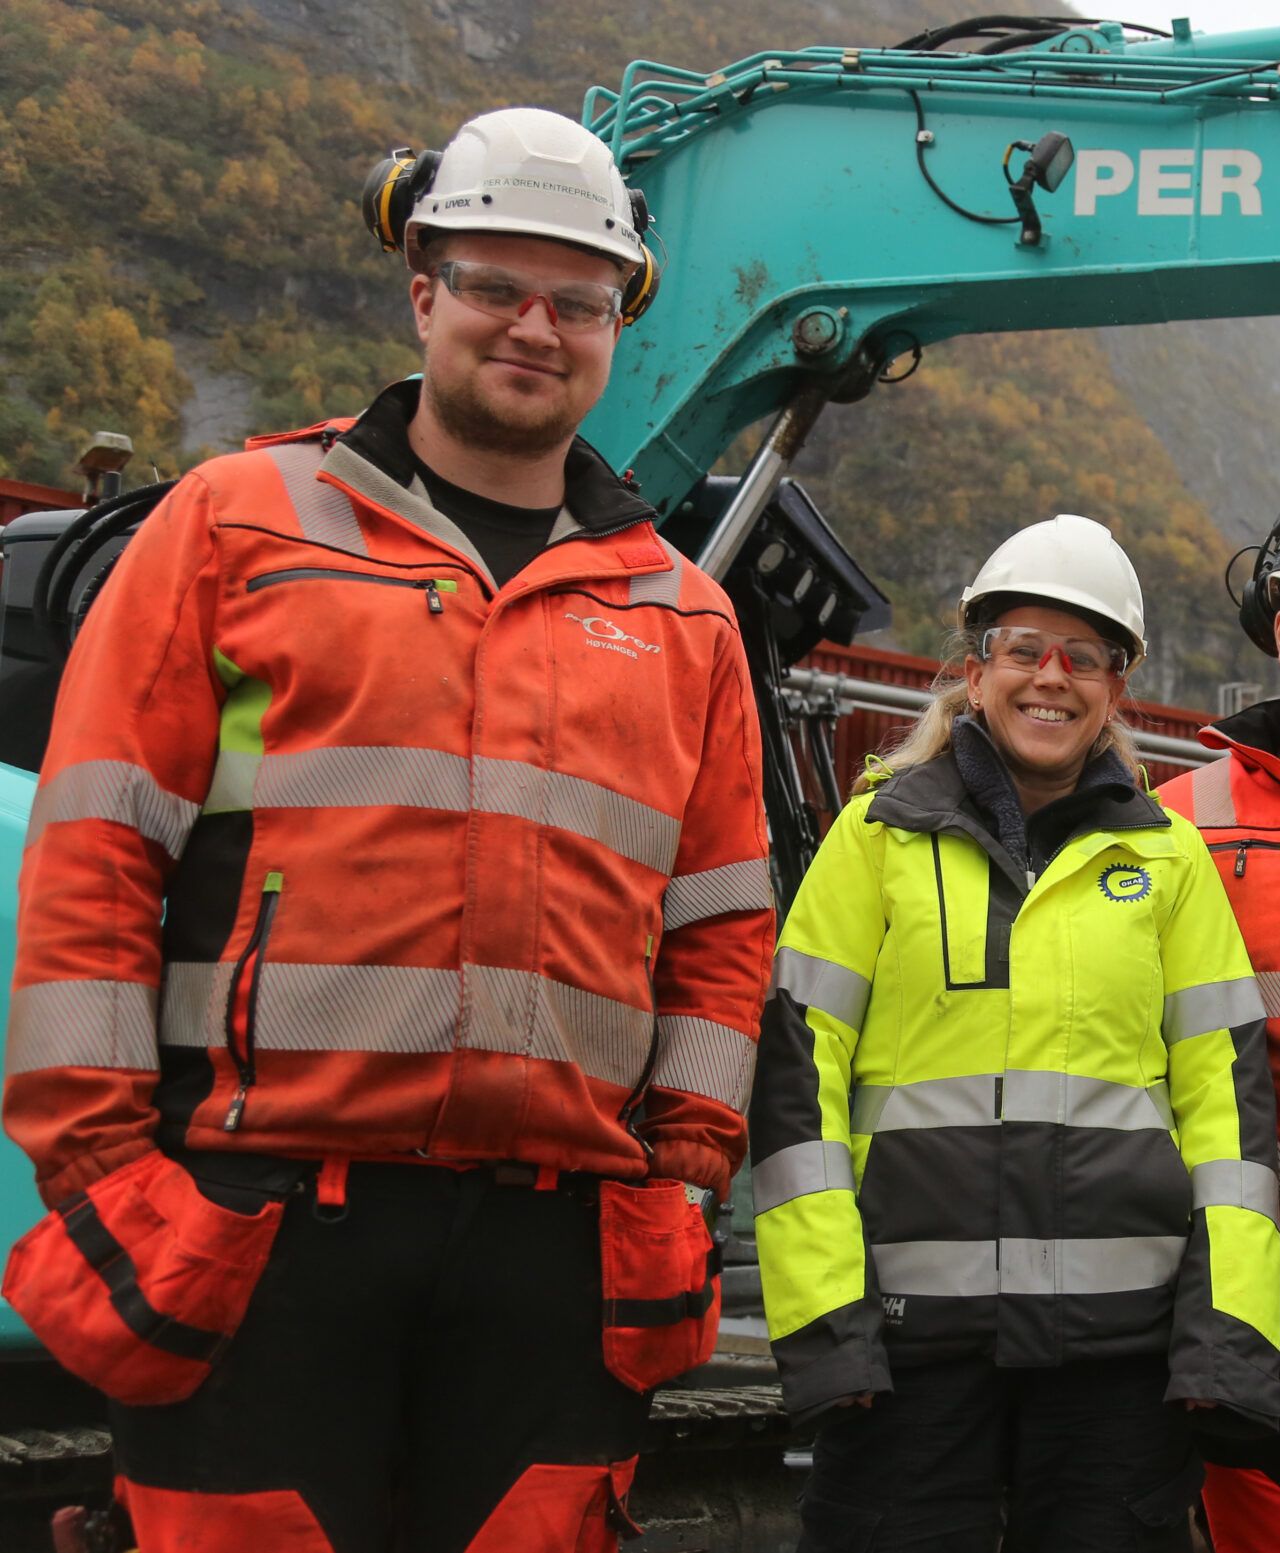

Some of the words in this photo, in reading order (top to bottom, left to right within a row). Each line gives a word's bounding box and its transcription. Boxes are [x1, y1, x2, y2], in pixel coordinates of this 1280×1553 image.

[512, 178, 540, 189] ØREN
[1074, 148, 1262, 217] PER
[444, 197, 471, 209] uvex
[586, 638, 638, 660] HØYANGER
